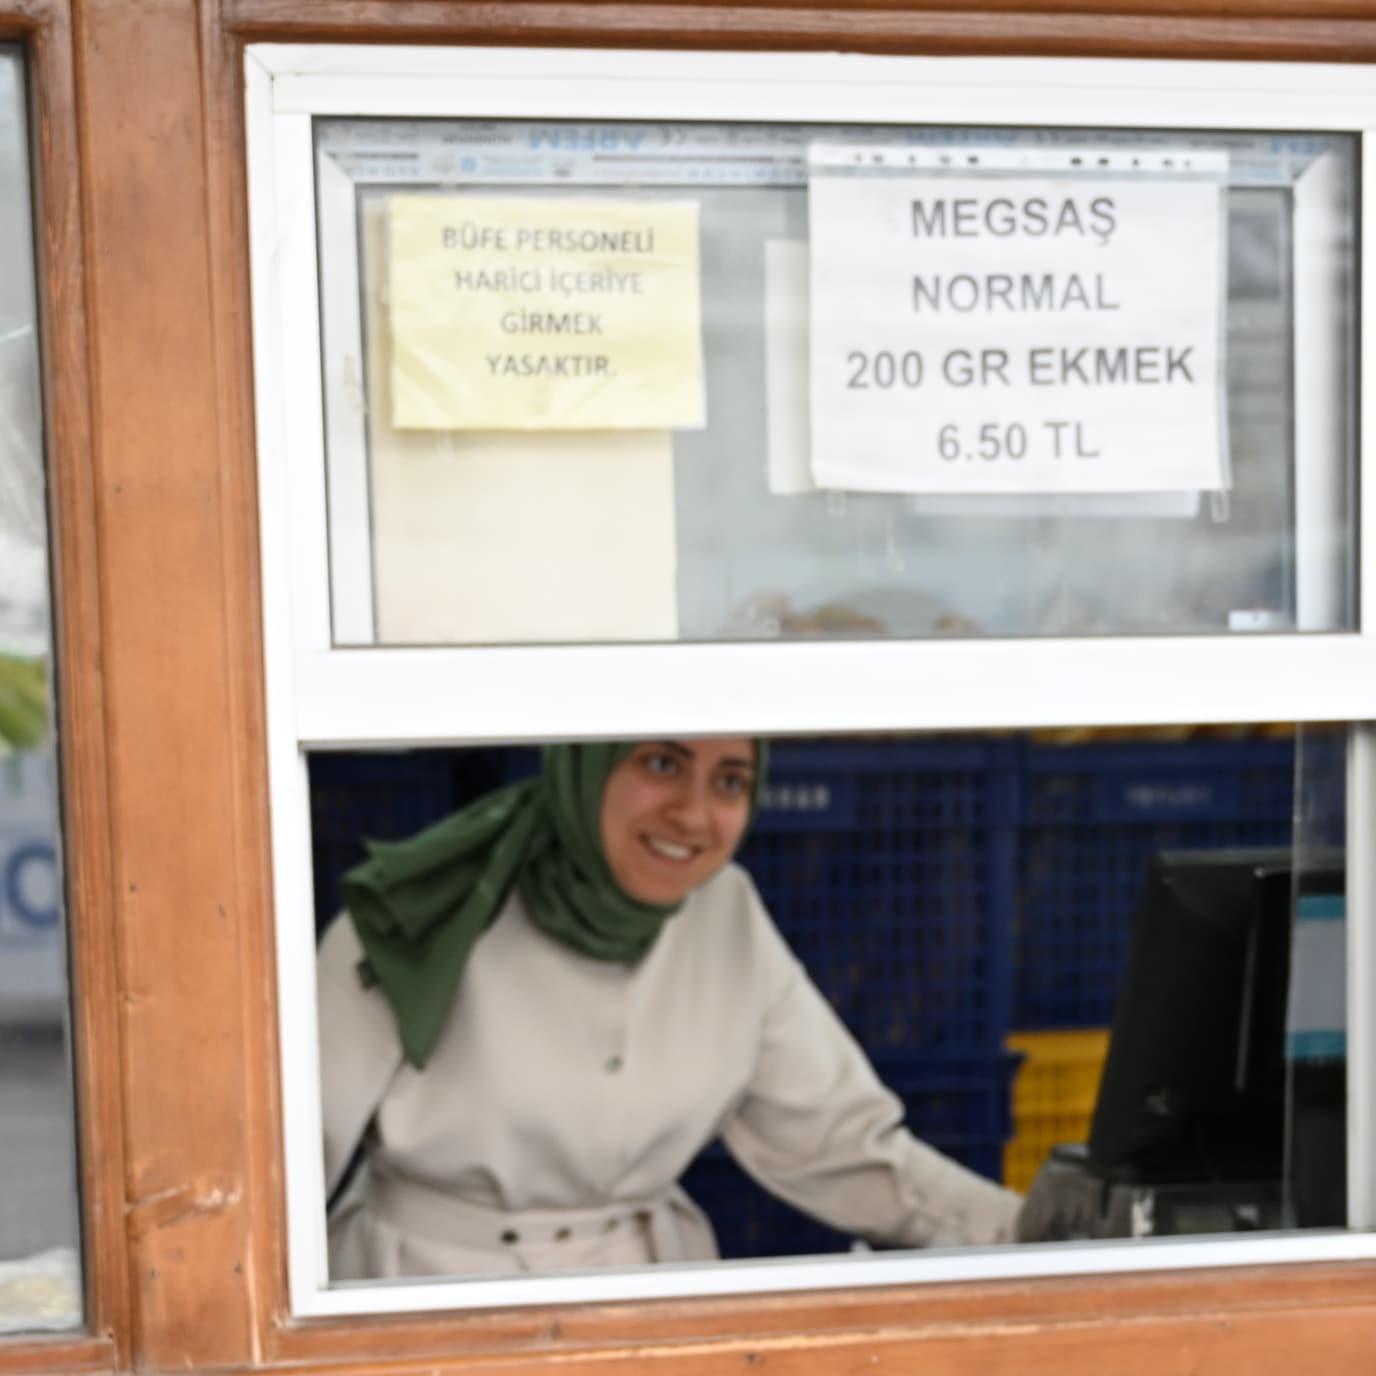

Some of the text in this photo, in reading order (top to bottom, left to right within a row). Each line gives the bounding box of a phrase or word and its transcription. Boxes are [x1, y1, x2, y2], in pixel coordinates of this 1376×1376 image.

[441, 220, 655, 254] BÜFE PERSONELİ
[910, 197, 1117, 247] MEGSAŞ
[912, 273, 1120, 313] NORMAL
[500, 307, 603, 335] GİRMEK
[485, 353, 617, 378] YASAKTIR.
[846, 346, 1195, 389] 200 GR EKMEK
[937, 421, 1101, 462] 6.50 TL
